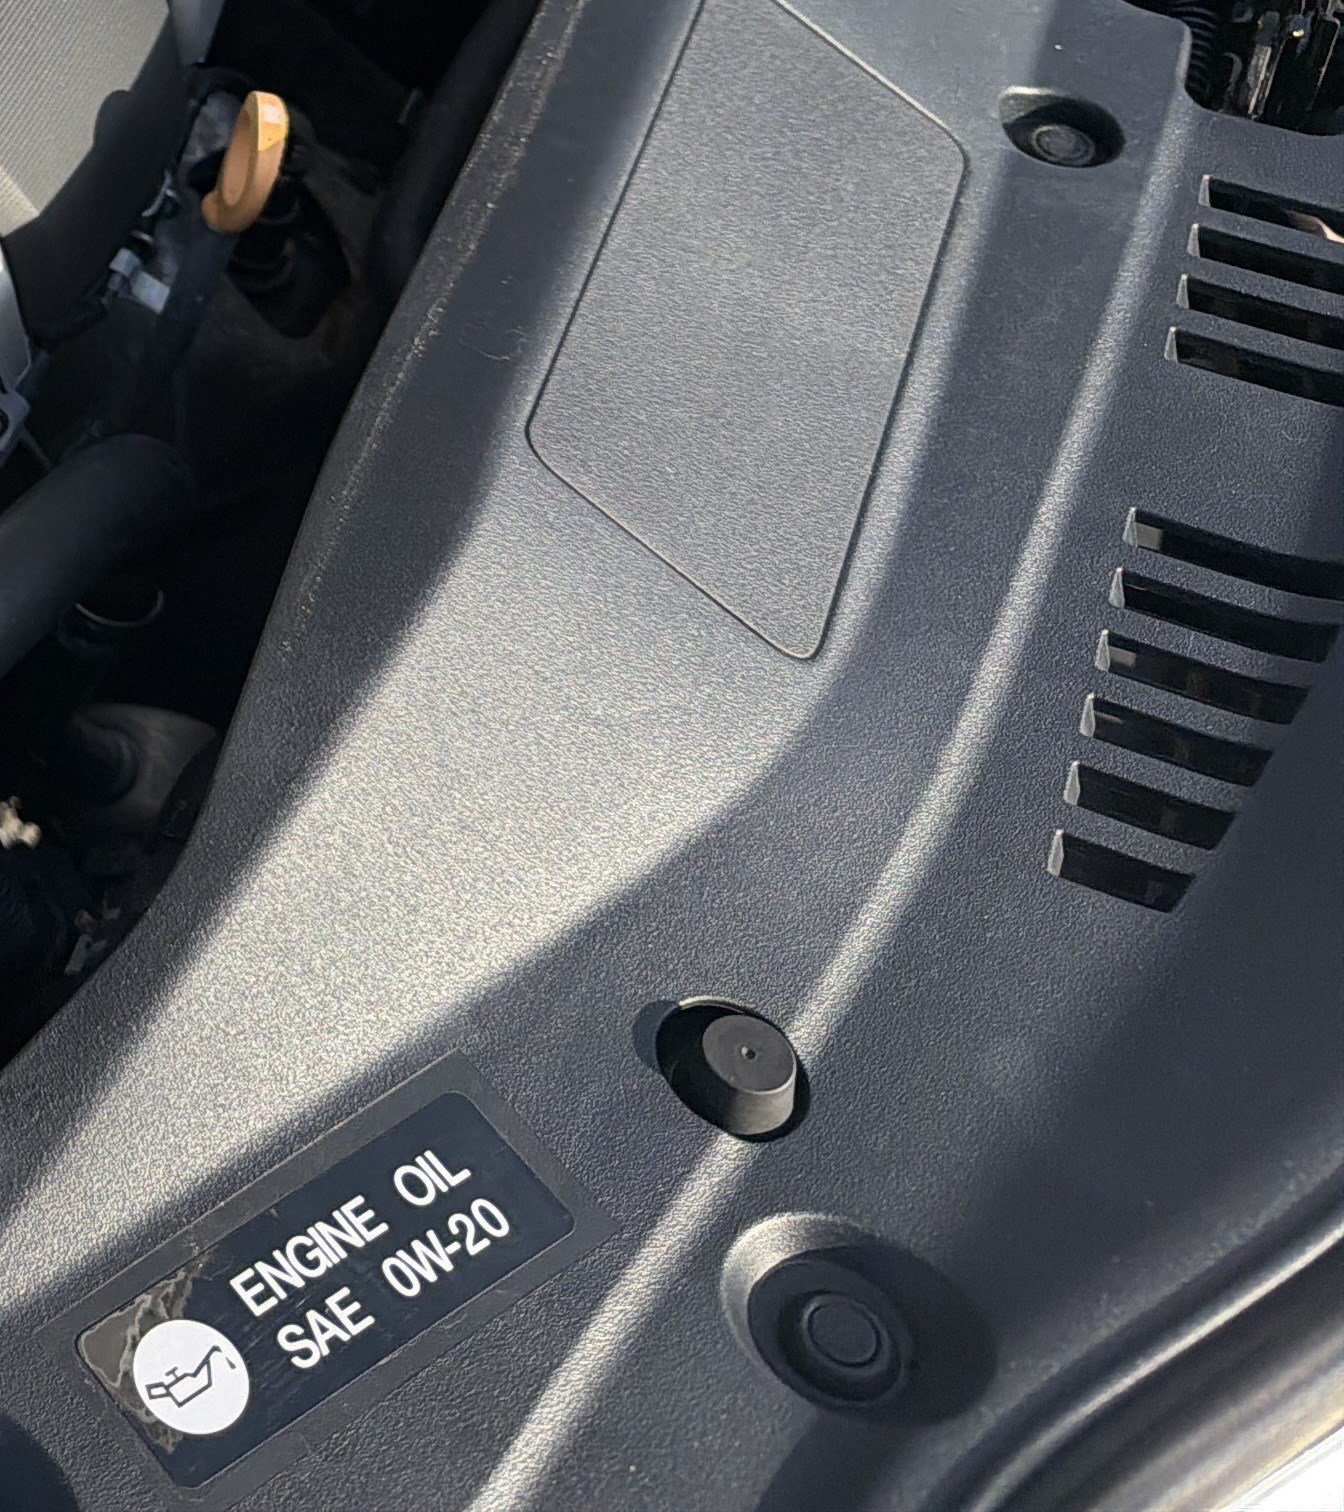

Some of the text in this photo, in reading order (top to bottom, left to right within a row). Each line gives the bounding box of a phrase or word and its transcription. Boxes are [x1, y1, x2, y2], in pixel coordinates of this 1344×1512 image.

[229, 1149, 472, 1317] ENGINE OIL
[276, 1198, 510, 1369] SAE 0W-20
